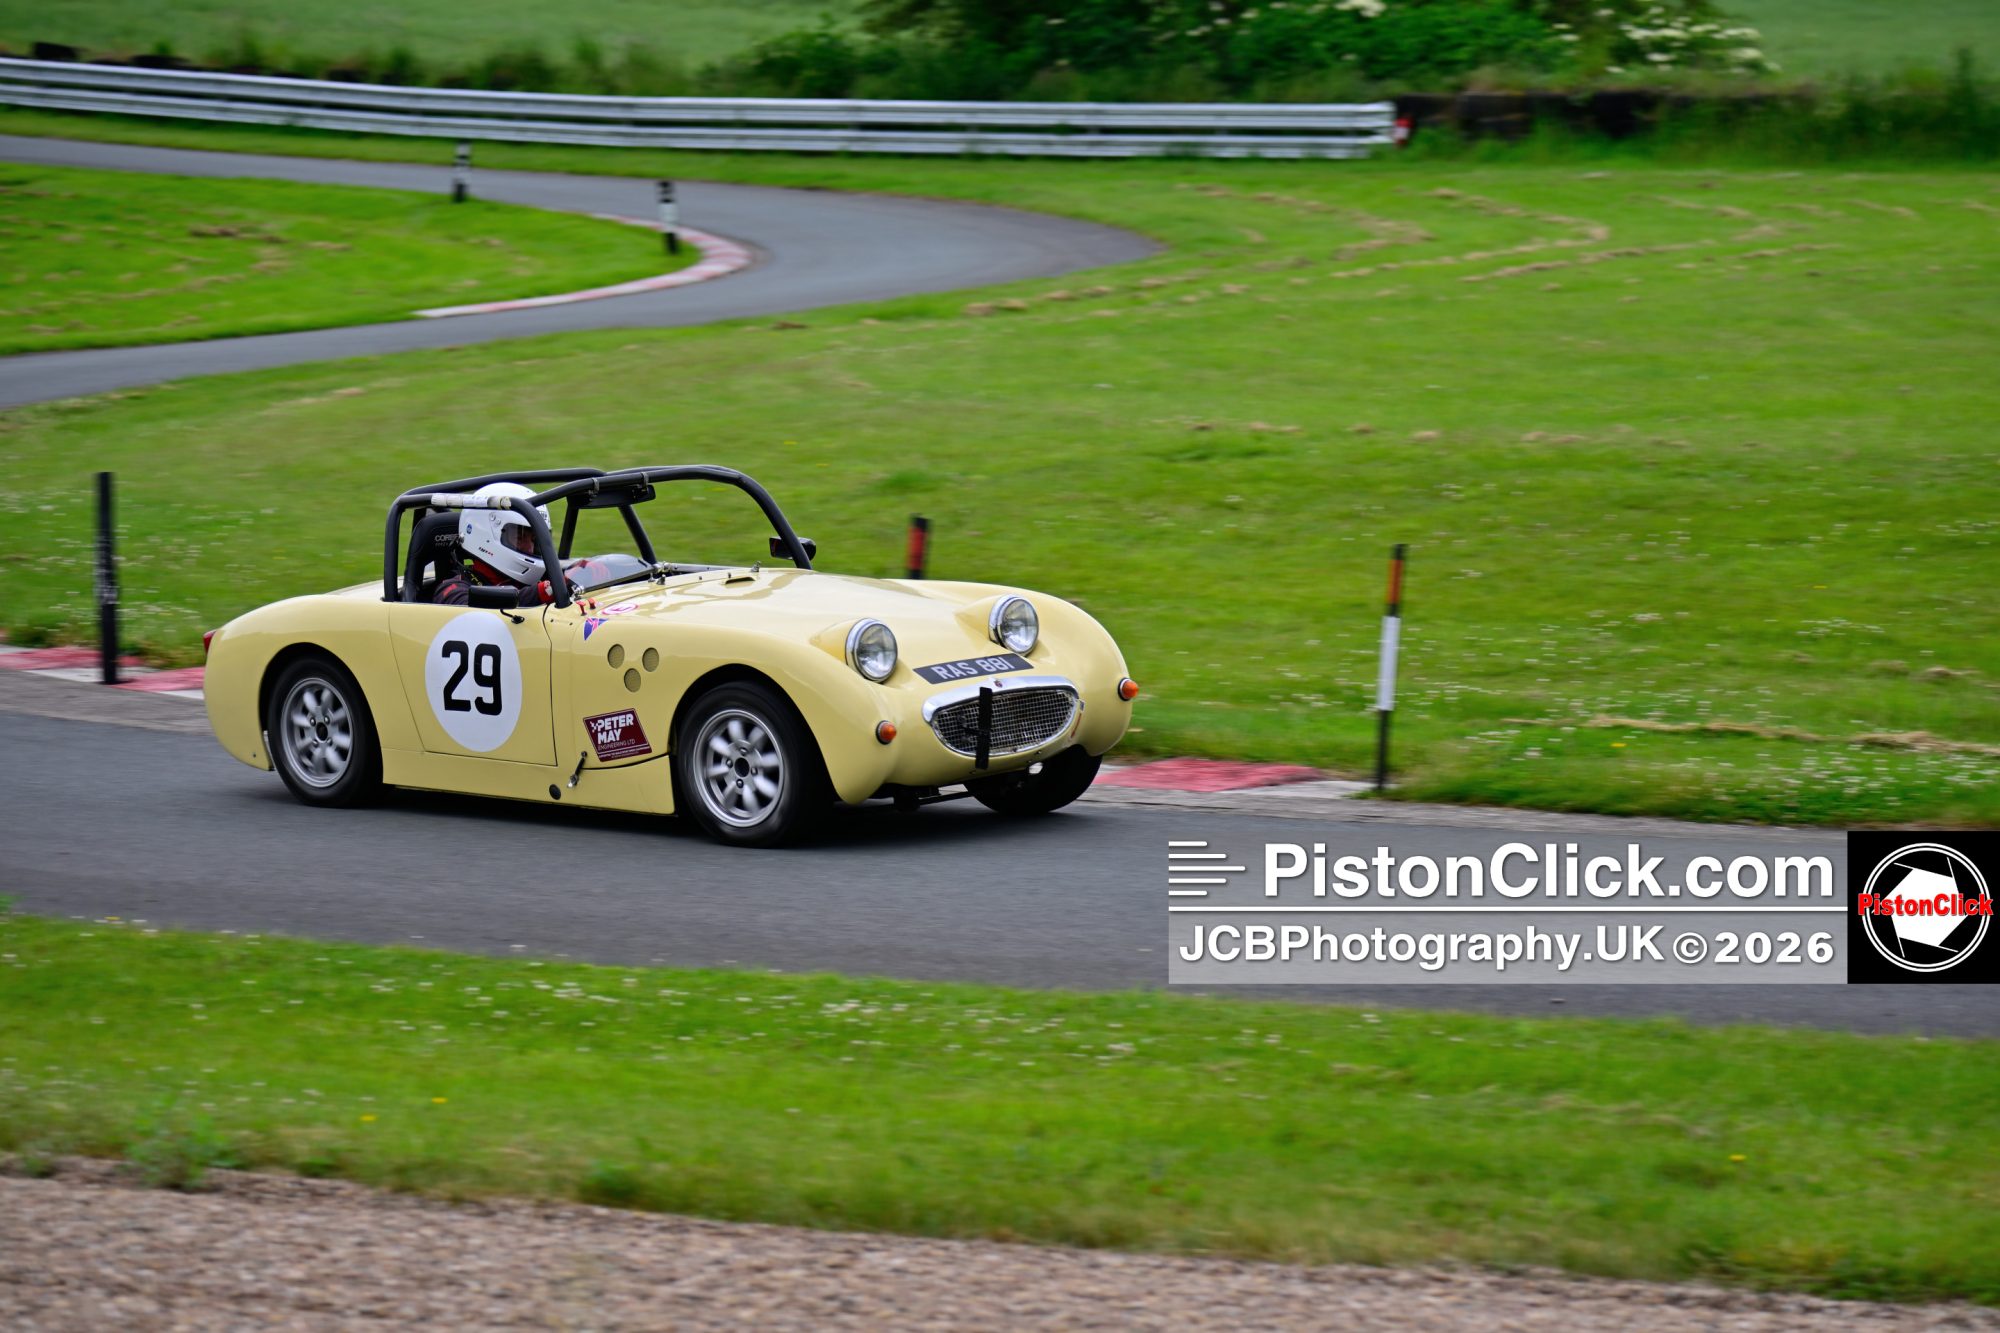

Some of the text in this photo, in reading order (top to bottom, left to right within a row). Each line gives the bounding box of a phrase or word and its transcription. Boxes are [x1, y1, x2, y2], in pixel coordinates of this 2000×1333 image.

[441, 640, 503, 716] 29
[931, 662, 975, 680] RAS
[597, 713, 634, 732] PETER
[597, 728, 622, 745] MAY
[597, 738, 636, 750] ENGINEERING LTD
